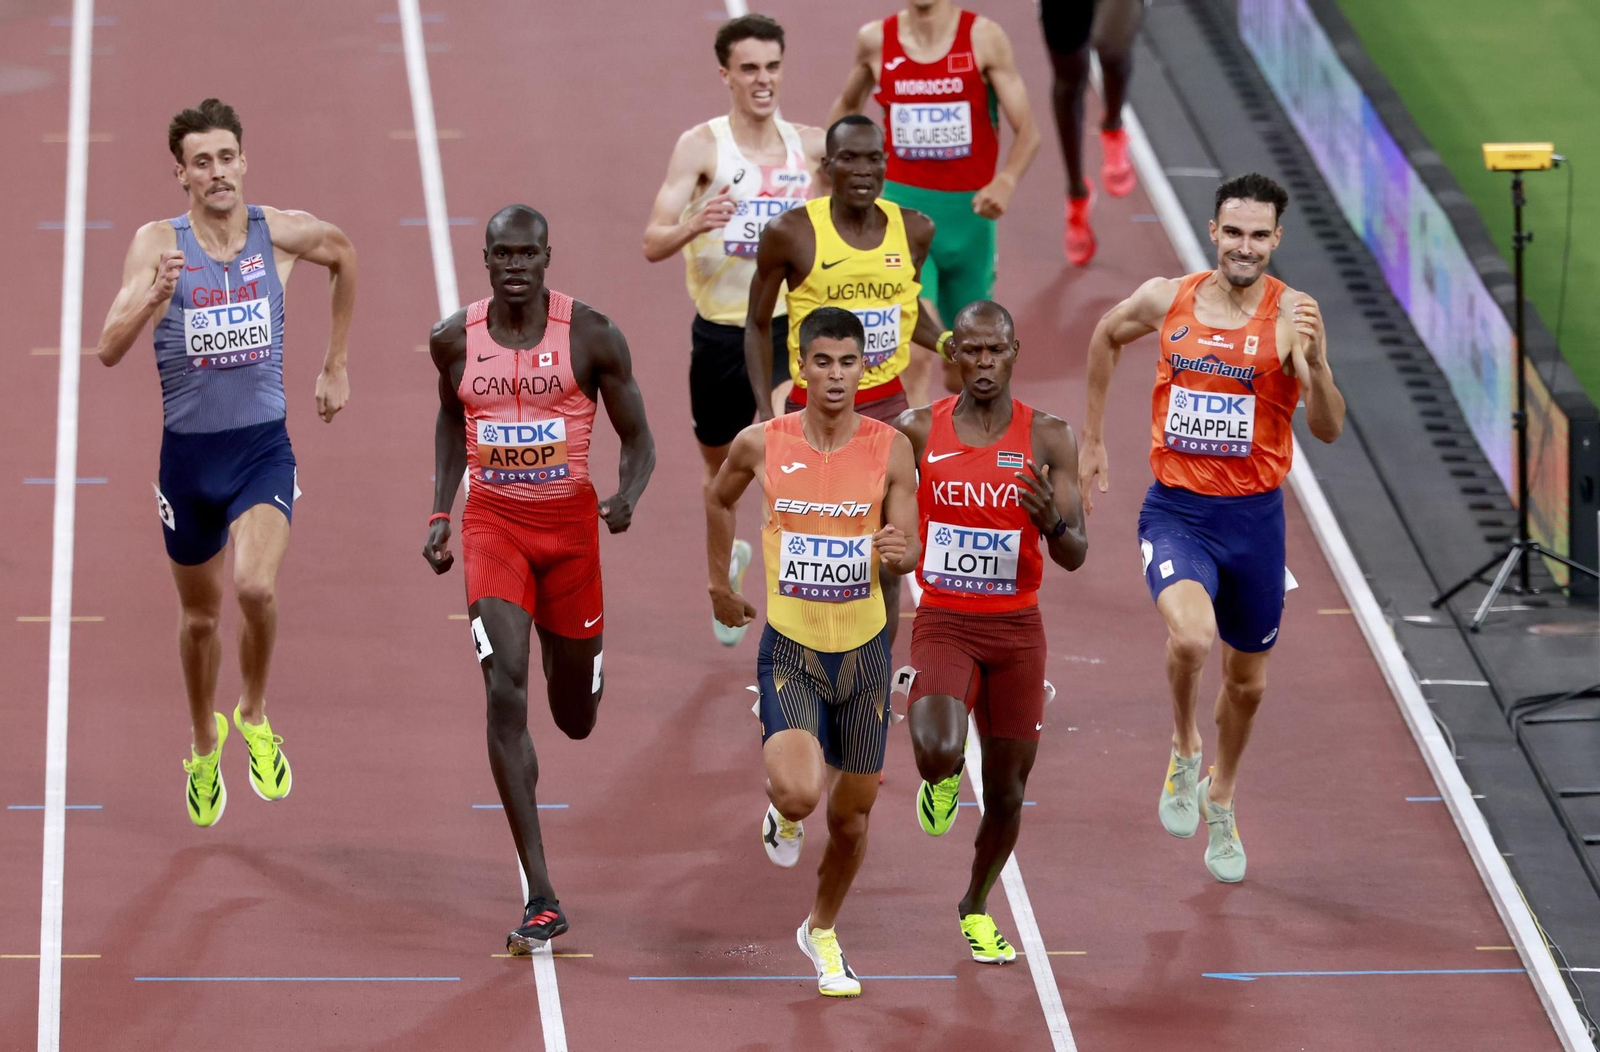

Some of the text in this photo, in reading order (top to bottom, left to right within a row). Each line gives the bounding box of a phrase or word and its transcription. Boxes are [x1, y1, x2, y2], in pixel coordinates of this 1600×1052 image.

[911, 106, 962, 123] TDK
[896, 125, 967, 145] EL GUESSE
[192, 280, 259, 308] GREAT
[827, 282, 903, 300] UGANDA
[207, 302, 265, 327] TDK
[191, 324, 268, 352] CRORKEN
[472, 375, 564, 396] CANADA
[1187, 393, 1247, 415] TDK
[497, 422, 559, 443] TDK
[1170, 412, 1249, 439] CHAPPLE
[489, 445, 555, 466] AROP
[932, 480, 1020, 508] KENYA
[774, 498, 873, 518] ESPAÑA
[806, 537, 866, 558] TDK
[953, 529, 1013, 552] TDK
[784, 560, 867, 583] ATTAOUI
[944, 551, 999, 575] LOTI
